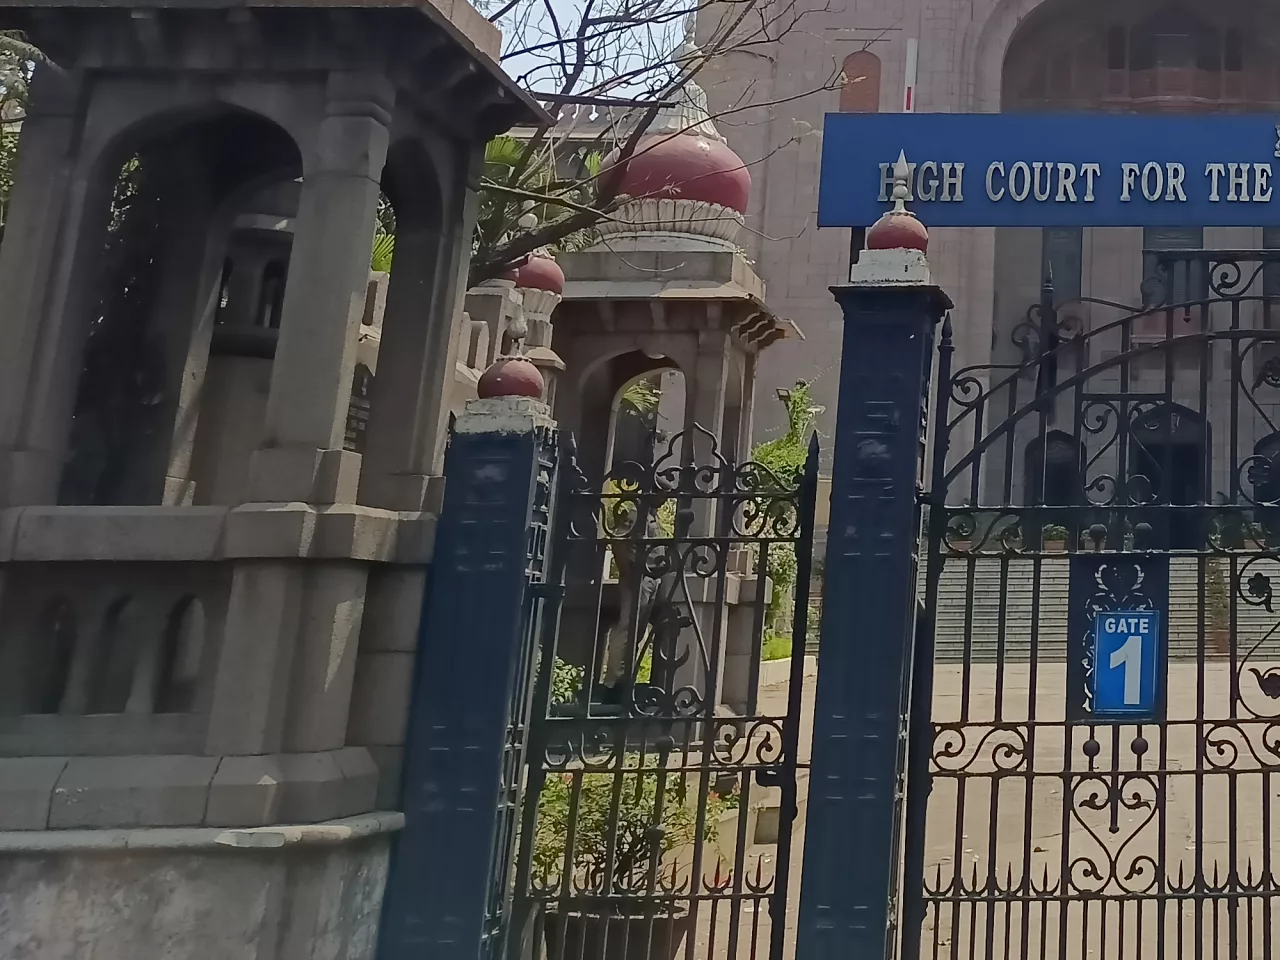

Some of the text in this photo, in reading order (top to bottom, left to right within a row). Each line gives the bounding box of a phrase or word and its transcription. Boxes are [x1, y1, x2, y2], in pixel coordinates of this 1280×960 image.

[877, 160, 965, 202] HIGH
[985, 160, 1101, 202] COURT
[1120, 161, 1187, 202] FOR
[1204, 162, 1273, 202] THE
[1104, 617, 1149, 634] GATE
[1109, 635, 1142, 705] 1
